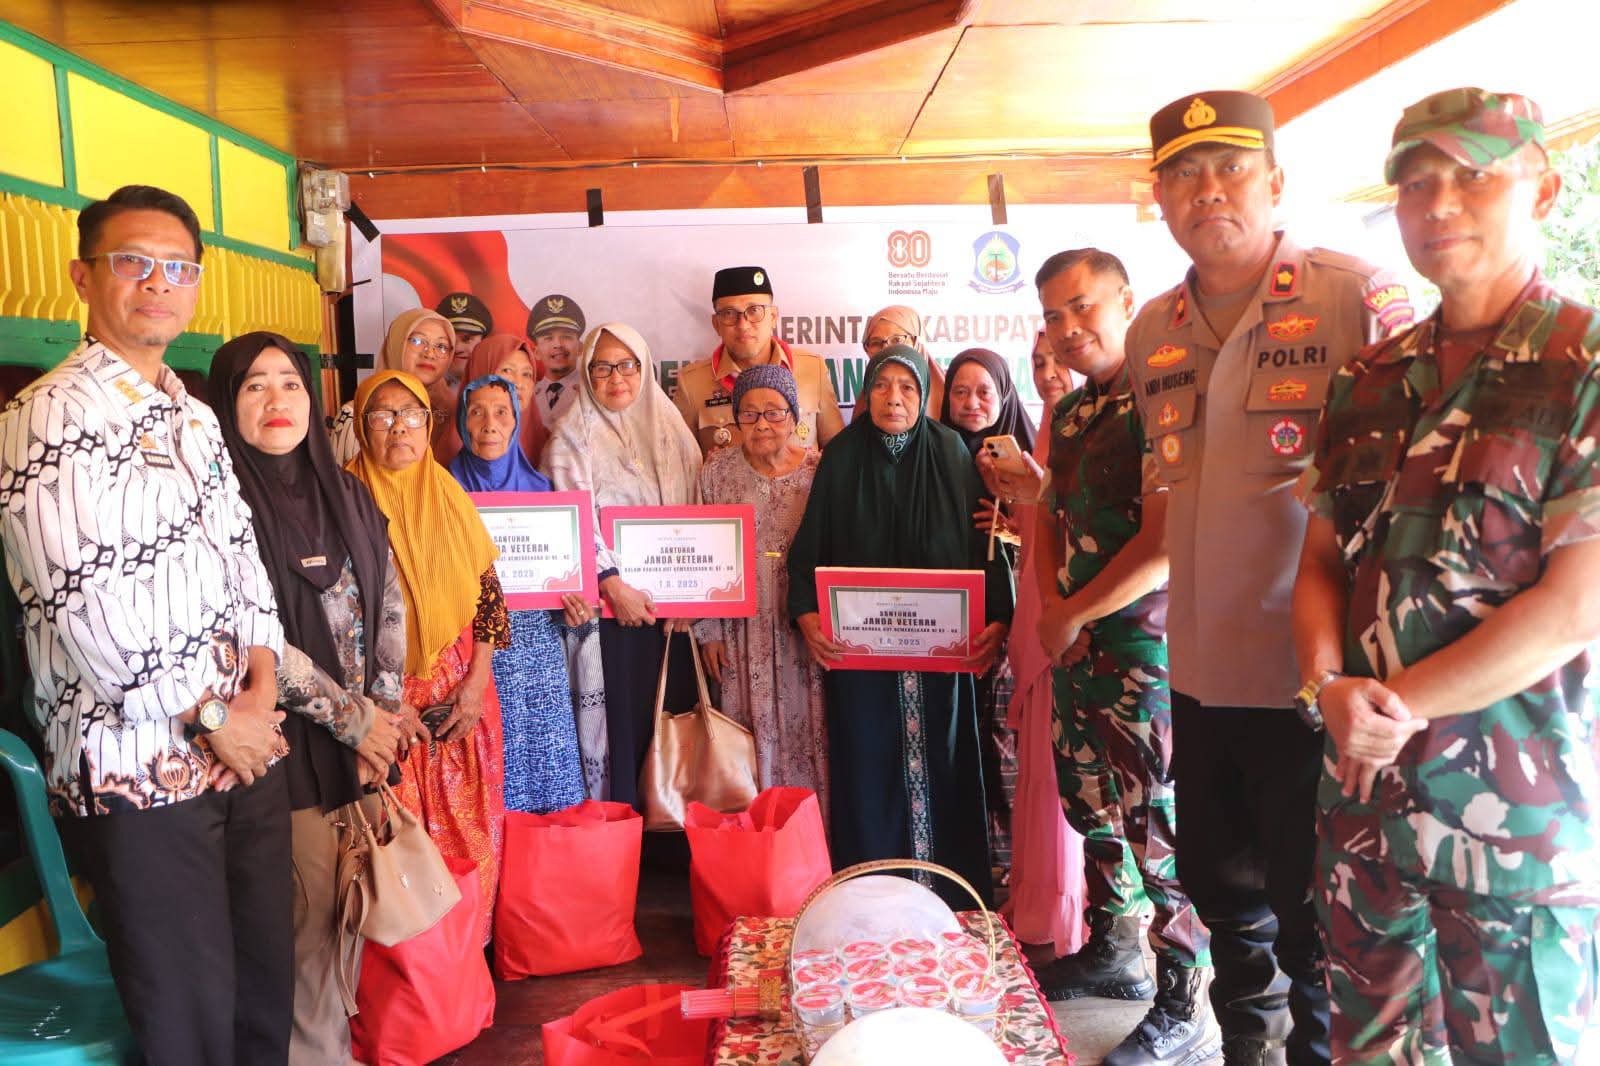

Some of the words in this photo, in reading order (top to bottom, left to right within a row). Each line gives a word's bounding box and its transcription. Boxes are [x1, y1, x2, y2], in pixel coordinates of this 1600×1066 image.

[887, 230, 931, 268] 80
[773, 315, 872, 345] ERINT
[922, 314, 1042, 343] KABUPAT
[1257, 346, 1327, 369] POLRI
[510, 543, 549, 553] VETERAN
[660, 546, 695, 554] SANTUNAN
[644, 555, 673, 564] JANDA
[676, 554, 714, 564] VETERAN
[678, 579, 698, 588] 2025
[863, 617, 893, 626] JANDA
[896, 618, 937, 626] VETERAN
[898, 638, 920, 646] 2025
